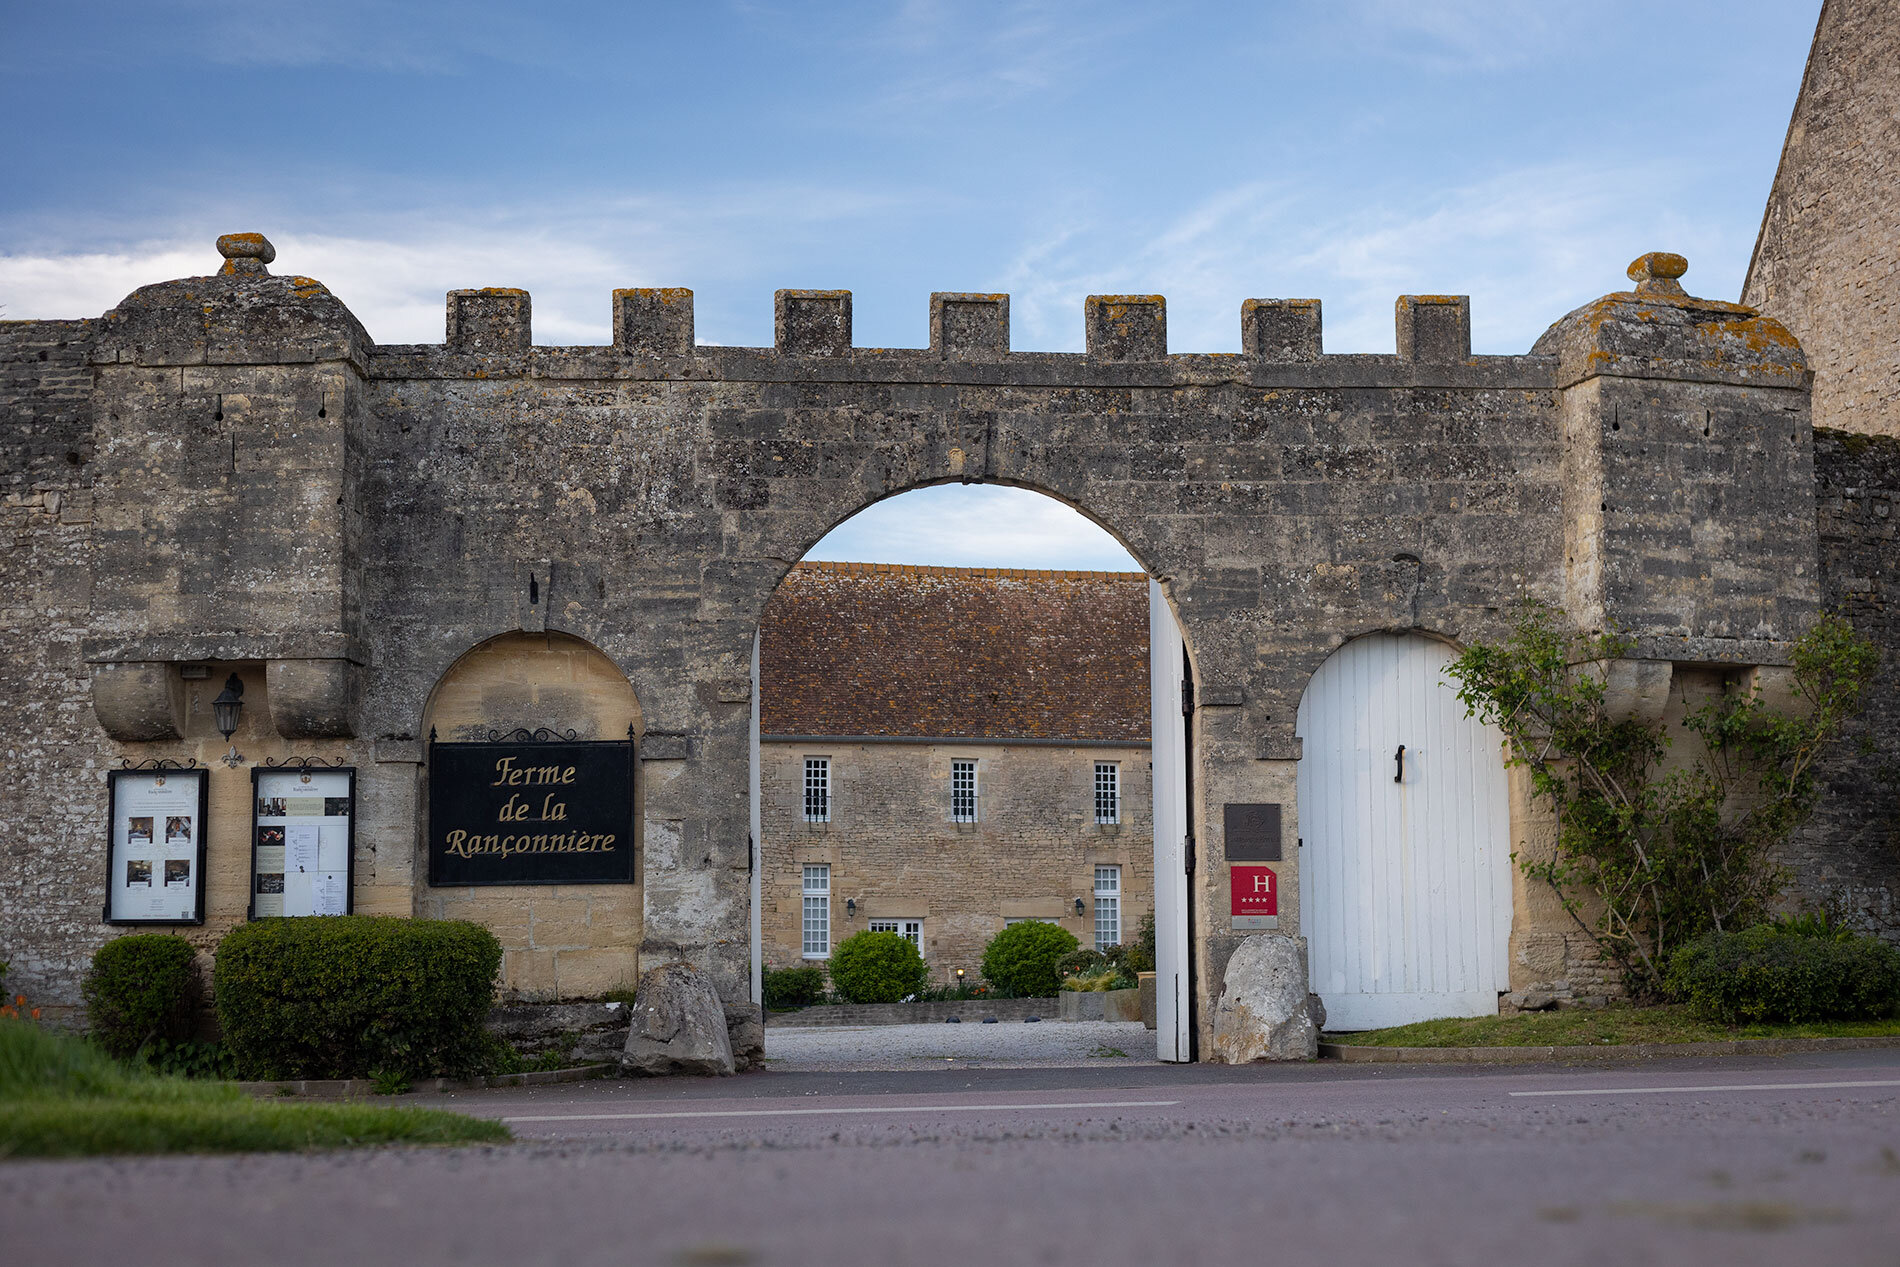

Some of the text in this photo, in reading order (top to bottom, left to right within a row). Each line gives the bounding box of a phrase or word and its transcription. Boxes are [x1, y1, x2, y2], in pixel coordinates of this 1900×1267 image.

[492, 756, 576, 786] Ferme
[498, 793, 567, 822] de la
[445, 829, 616, 859] Rançonnière
[1253, 875, 1271, 893] H
